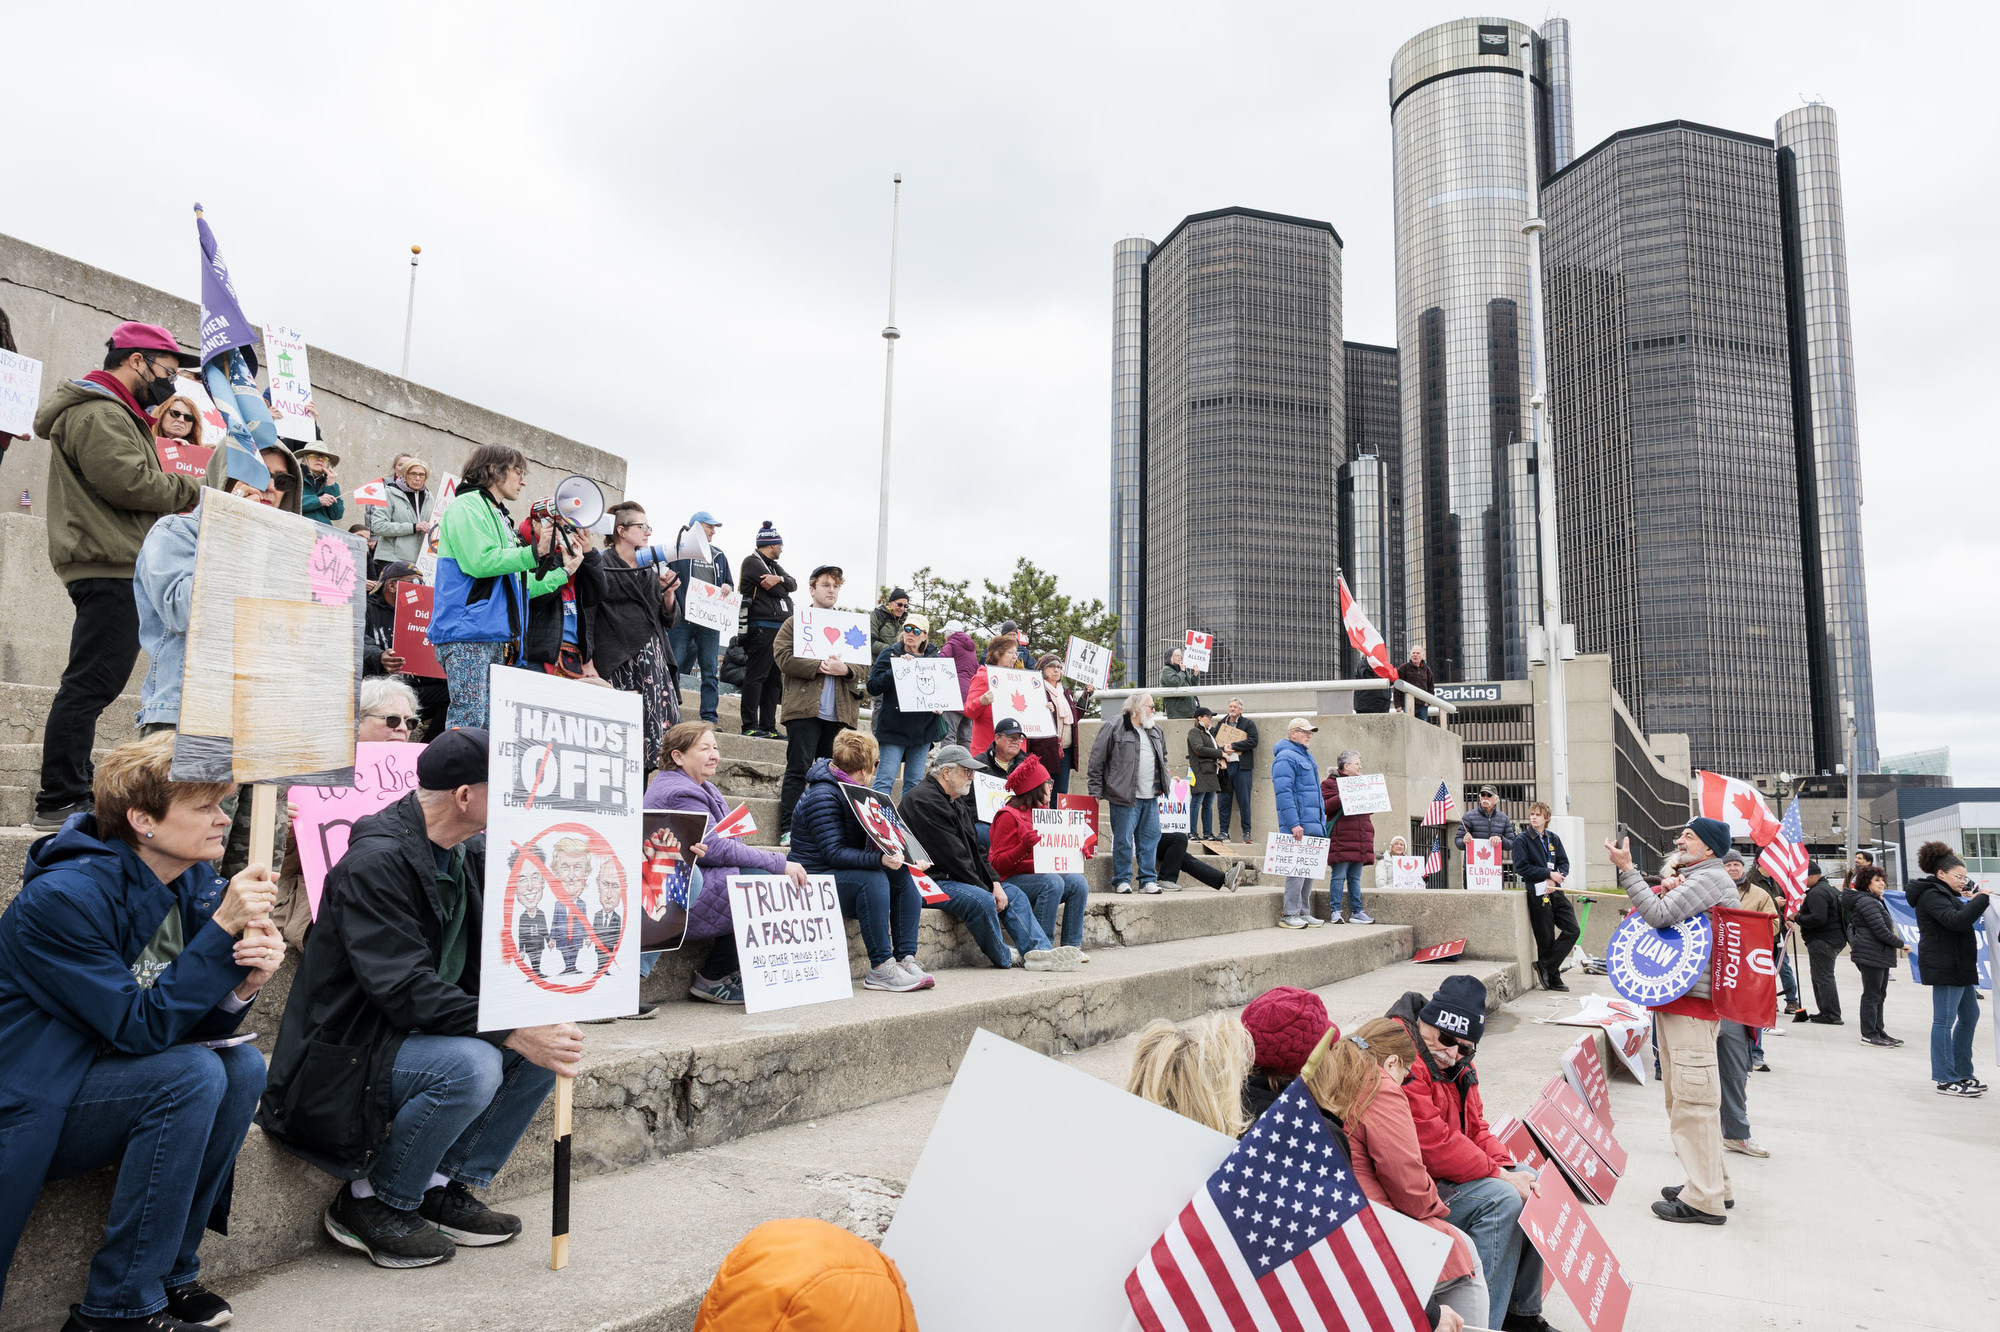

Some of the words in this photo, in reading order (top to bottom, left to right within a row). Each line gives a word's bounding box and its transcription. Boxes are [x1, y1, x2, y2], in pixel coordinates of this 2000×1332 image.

[176, 462, 192, 472] Did
[315, 544, 355, 593] SAVE
[415, 609, 430, 620] Did
[719, 613, 732, 631] Up
[1434, 686, 1497, 700] Parking
[916, 696, 949, 710] Meow
[521, 707, 624, 753] HANDS
[520, 744, 625, 805] OFF!
[1158, 802, 1187, 815] CANADA
[1033, 809, 1062, 825] HANDS
[1068, 811, 1084, 827] OFF
[1276, 844, 1294, 854] FREE
[1298, 846, 1320, 856] SPEECH
[1054, 856, 1068, 872] EH
[1275, 855, 1293, 865] FREE
[1296, 857, 1319, 867] PRESS
[1274, 865, 1311, 877] PBS/NPR
[1468, 866, 1503, 877] ELBOWS
[1475, 878, 1490, 886] UP!
[735, 880, 814, 919] TRUMP
[817, 881, 836, 911] IS
[745, 923, 760, 949] A
[761, 916, 834, 946] FASCIST!
[768, 952, 789, 965] OTHER
[790, 950, 813, 963] THINGS
[1636, 934, 1679, 968] UAW
[763, 970, 778, 983] PUT
[782, 969, 794, 981] ON
[1437, 1009, 1470, 1031] DDR
[1560, 1201, 1571, 1215] for
[1557, 1209, 1567, 1228] vote
[1553, 1222, 1562, 1242] you
[1546, 1231, 1557, 1252] Did
[1591, 1283, 1603, 1308] Social
[1589, 1301, 1598, 1326] and
